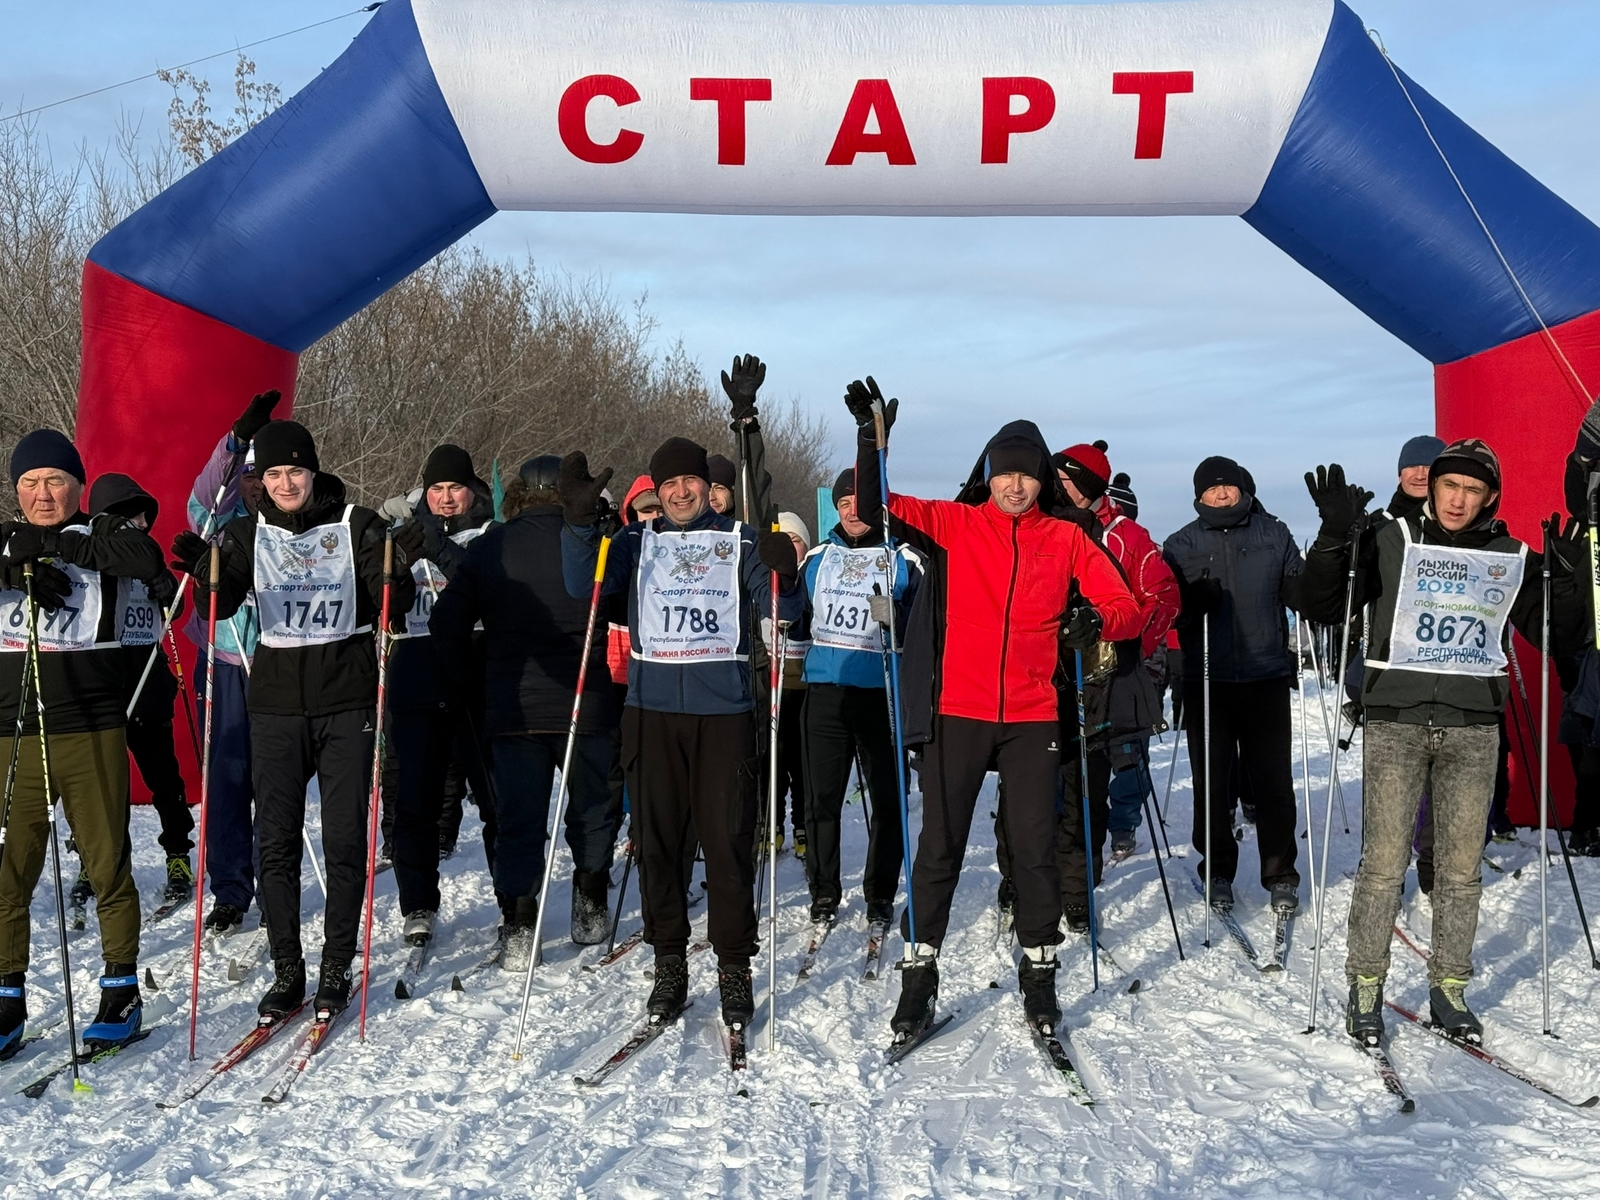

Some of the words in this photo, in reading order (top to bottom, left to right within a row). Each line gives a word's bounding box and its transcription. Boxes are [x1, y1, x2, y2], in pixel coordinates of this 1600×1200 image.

[558, 72, 1193, 165] СТАРТ
[1417, 559, 1468, 572] ЛЫЖНЯ
[283, 570, 313, 580] РОССИИ
[675, 575, 705, 584] РОССИИ
[1417, 567, 1468, 581] РОССИИ
[1416, 579, 1466, 594] 2022
[1414, 600, 1439, 609] СПОРТ
[9, 599, 79, 634] 697
[283, 600, 343, 629] 1747
[662, 606, 719, 633] 1788
[825, 603, 869, 631] 1631
[1416, 613, 1486, 648] 8673
[680, 648, 710, 657] РОССИИ
